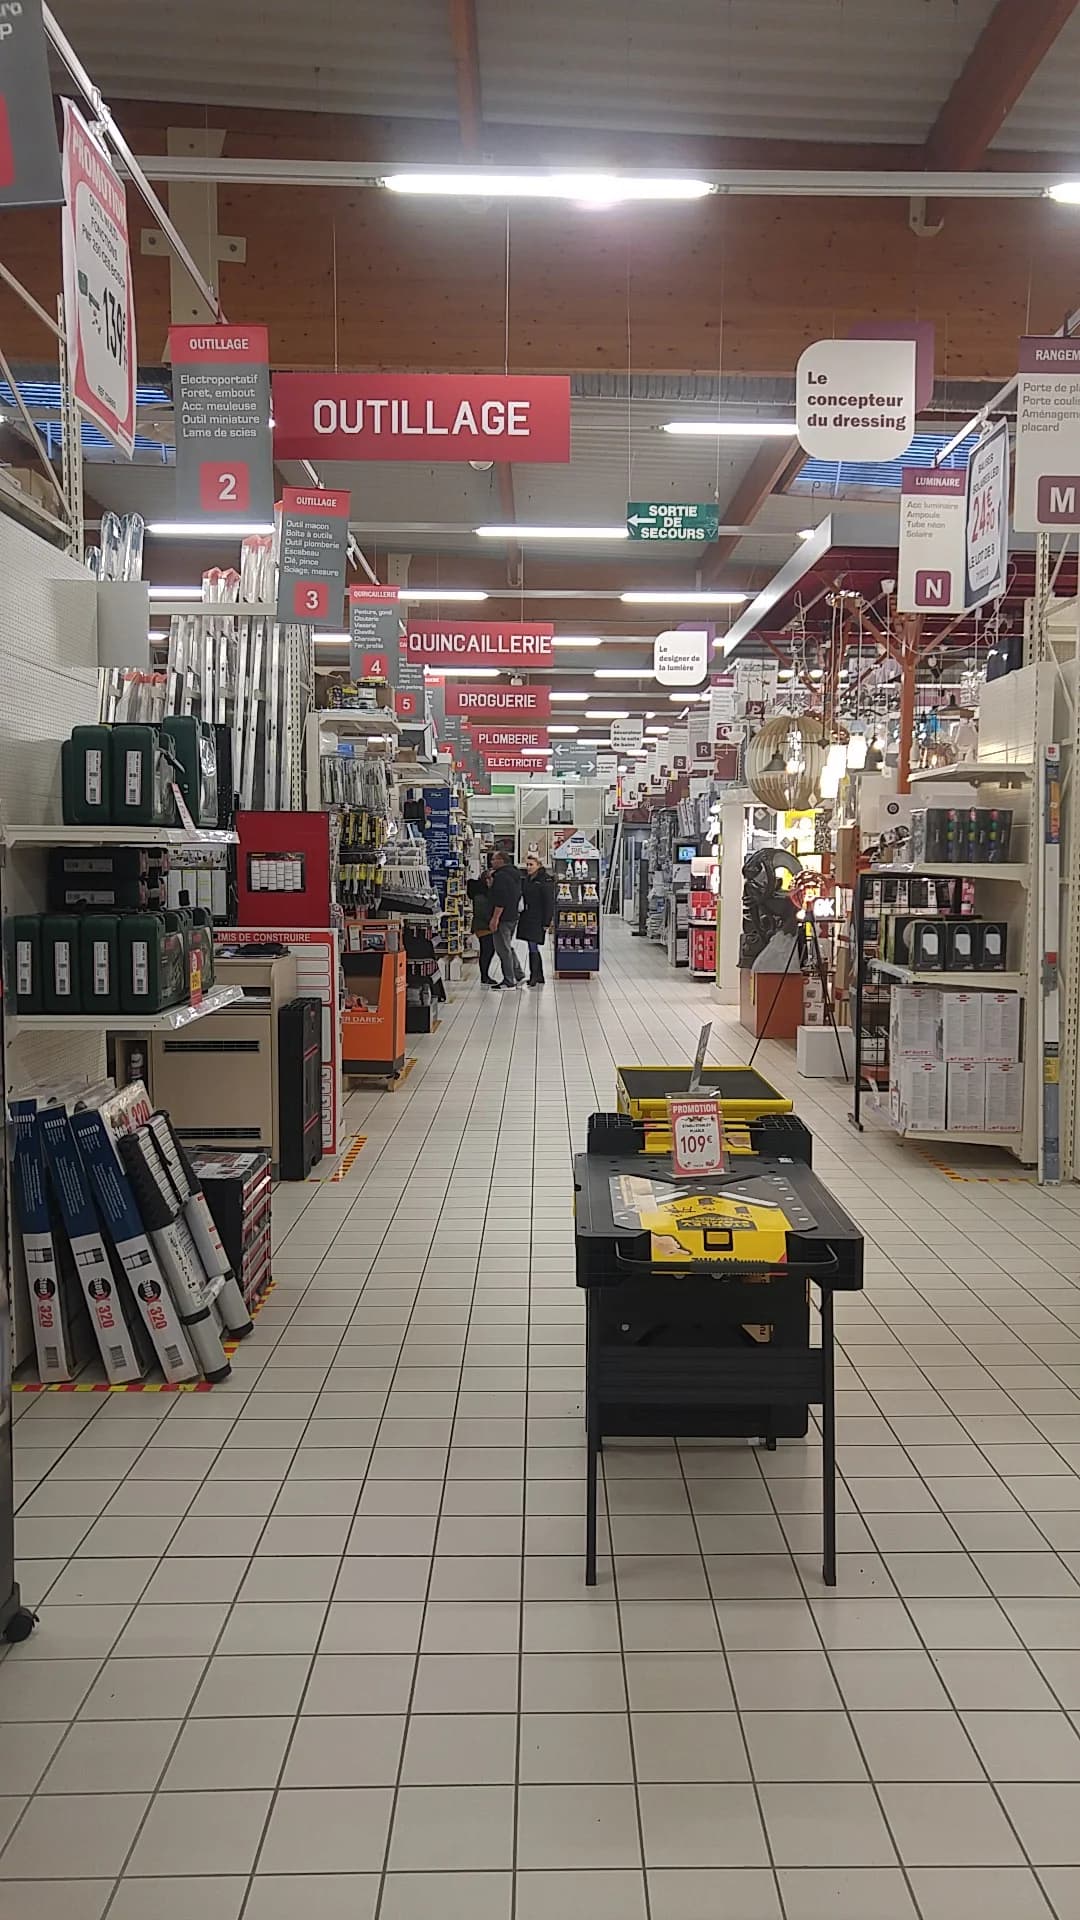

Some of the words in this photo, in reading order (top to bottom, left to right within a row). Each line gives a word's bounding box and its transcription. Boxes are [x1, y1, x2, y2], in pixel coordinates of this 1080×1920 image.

[189, 338, 249, 350] OUTILLAGE
[180, 374, 259, 386] Electroportatif
[807, 371, 828, 385] Le
[1023, 382, 1052, 392] Porte
[1054, 383, 1067, 392] de
[214, 388, 256, 398] embout
[807, 393, 904, 410] concepteur
[1022, 395, 1051, 405] Porte
[182, 401, 205, 411] Acc.
[207, 401, 257, 411] meuleuse
[182, 414, 207, 425] Outil
[209, 414, 260, 425] miniature
[312, 399, 531, 436] OUTILLAGE
[807, 413, 828, 427] du
[832, 413, 907, 431] dressing
[183, 428, 211, 438] Lame
[214, 428, 227, 438] de
[229, 428, 257, 438] scies
[1021, 423, 1060, 433] placard
[218, 473, 238, 501] 2
[915, 476, 960, 487] LUMINAIRE
[296, 496, 337, 507] OUTILLAGE
[1049, 487, 1076, 513] M
[648, 505, 698, 517] SORTIE
[906, 511, 940, 519] Ampoule
[286, 520, 304, 528] Outil
[663, 517, 683, 527] DE
[906, 520, 925, 528] Tube
[313, 532, 333, 540] outils
[640, 528, 705, 539] SECOURS
[285, 538, 303, 546] Outil
[303, 540, 340, 549] plomberie
[925, 578, 944, 599] N
[305, 590, 320, 609] 3
[409, 632, 552, 654] QUINCAILLERIE
[659, 645, 668, 653] Le
[658, 655, 690, 663] designer
[370, 659, 382, 675] 4
[402, 698, 412, 710] 5
[458, 692, 537, 708] DROGUERIE
[478, 733, 539, 745] PLOMBERIE
[701, 745, 708, 754] R
[487, 757, 543, 768] ELECTRICITE
[239, 932, 252, 942] DE
[253, 932, 312, 943] CONSTRUIRE
[672, 1103, 718, 1114] PROMOTION
[40, 1304, 54, 1328] 320
[98, 1303, 115, 1329] 320
[149, 1305, 168, 1331] 320
